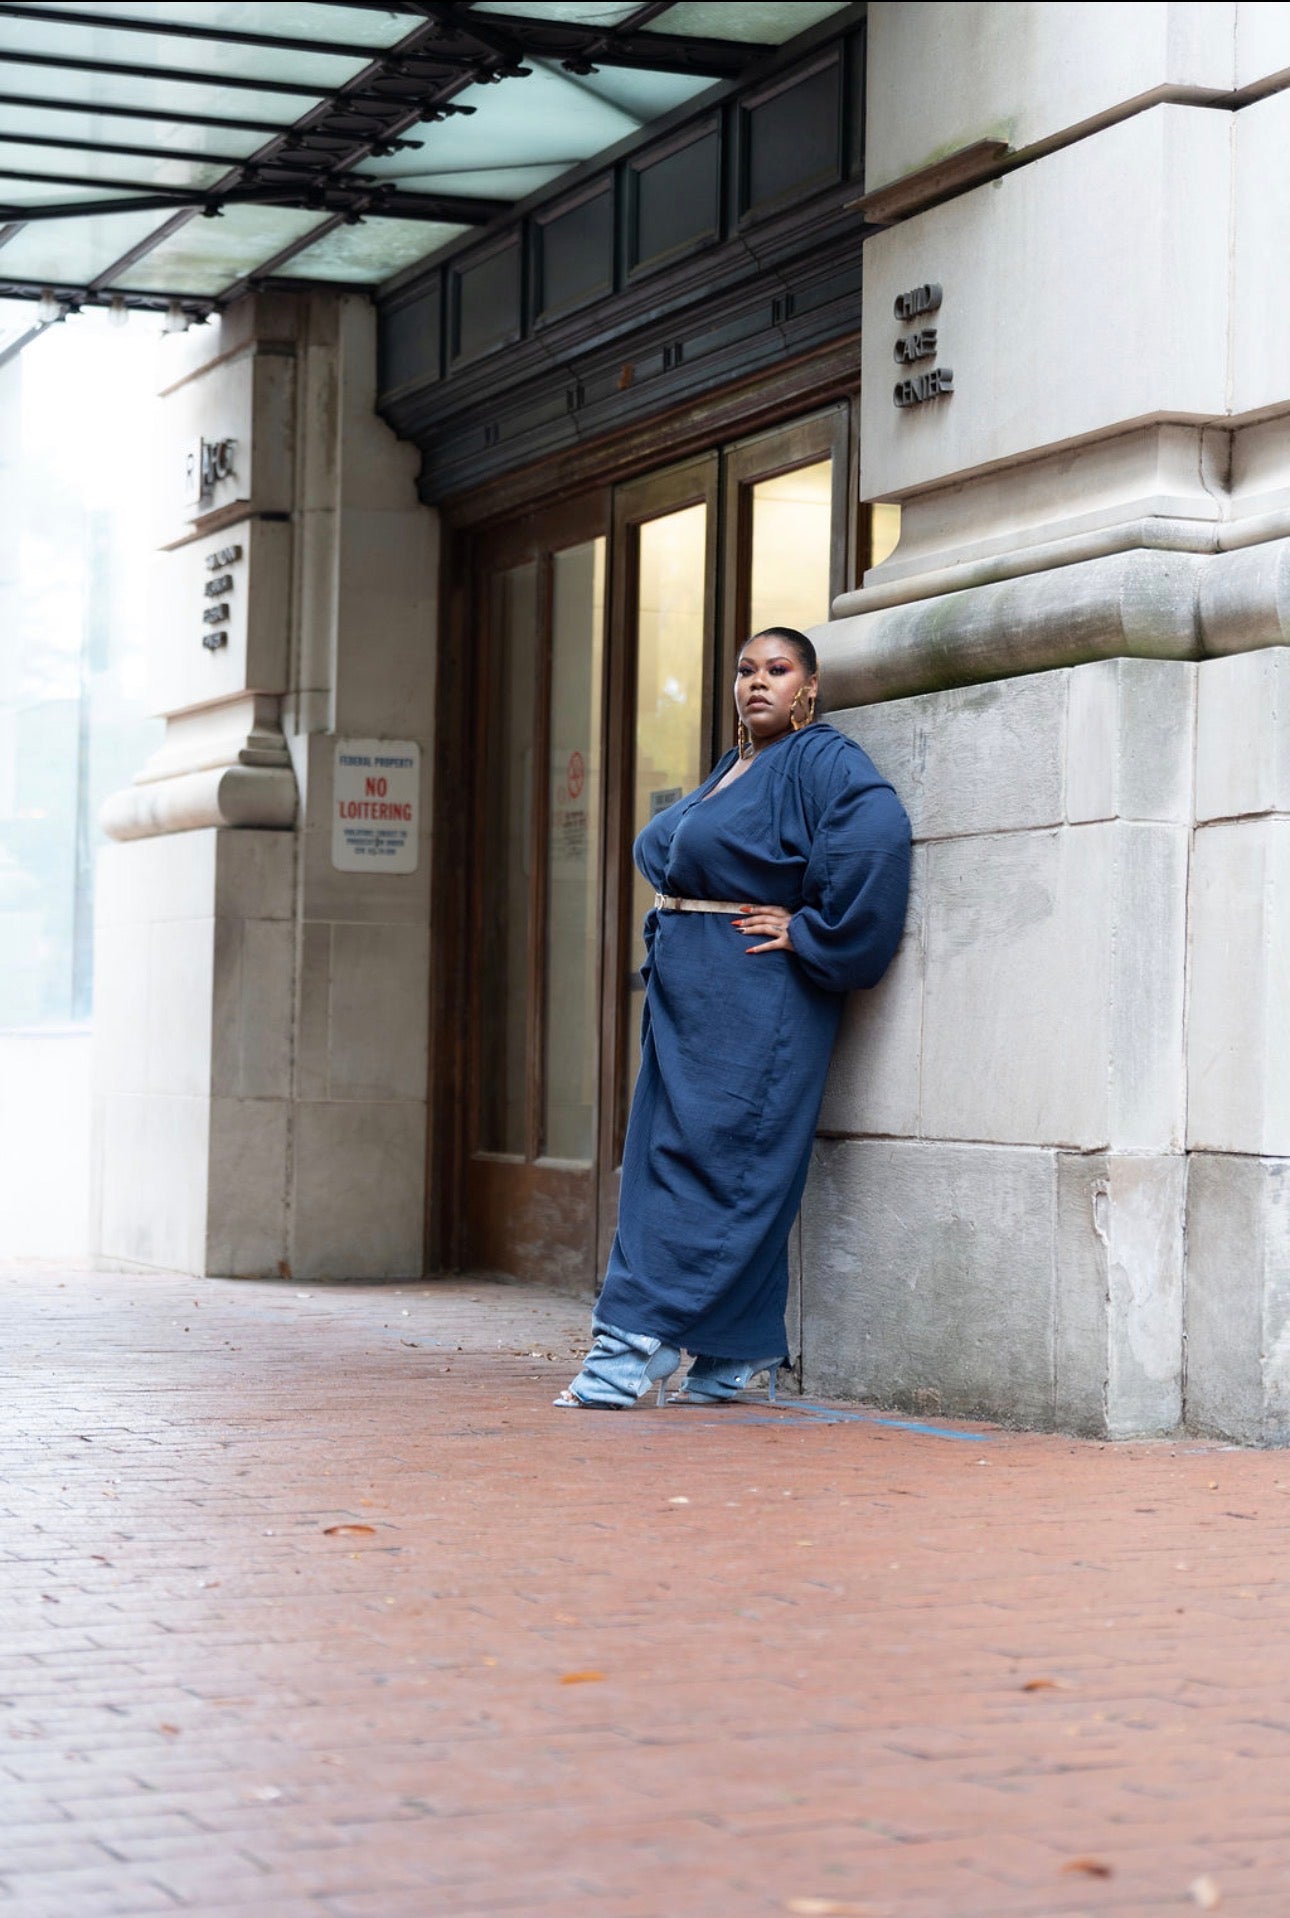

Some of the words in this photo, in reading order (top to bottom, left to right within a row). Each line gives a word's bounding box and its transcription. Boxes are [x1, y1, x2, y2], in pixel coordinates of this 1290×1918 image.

[893, 284, 943, 321] CHILD
[893, 329, 937, 364] CARE
[893, 368, 955, 408] CENTER
[339, 755, 371, 767] FEDERAL
[375, 757, 413, 769] PROPERTY
[365, 777, 388, 798] NO
[339, 800, 413, 821] LOITERING
